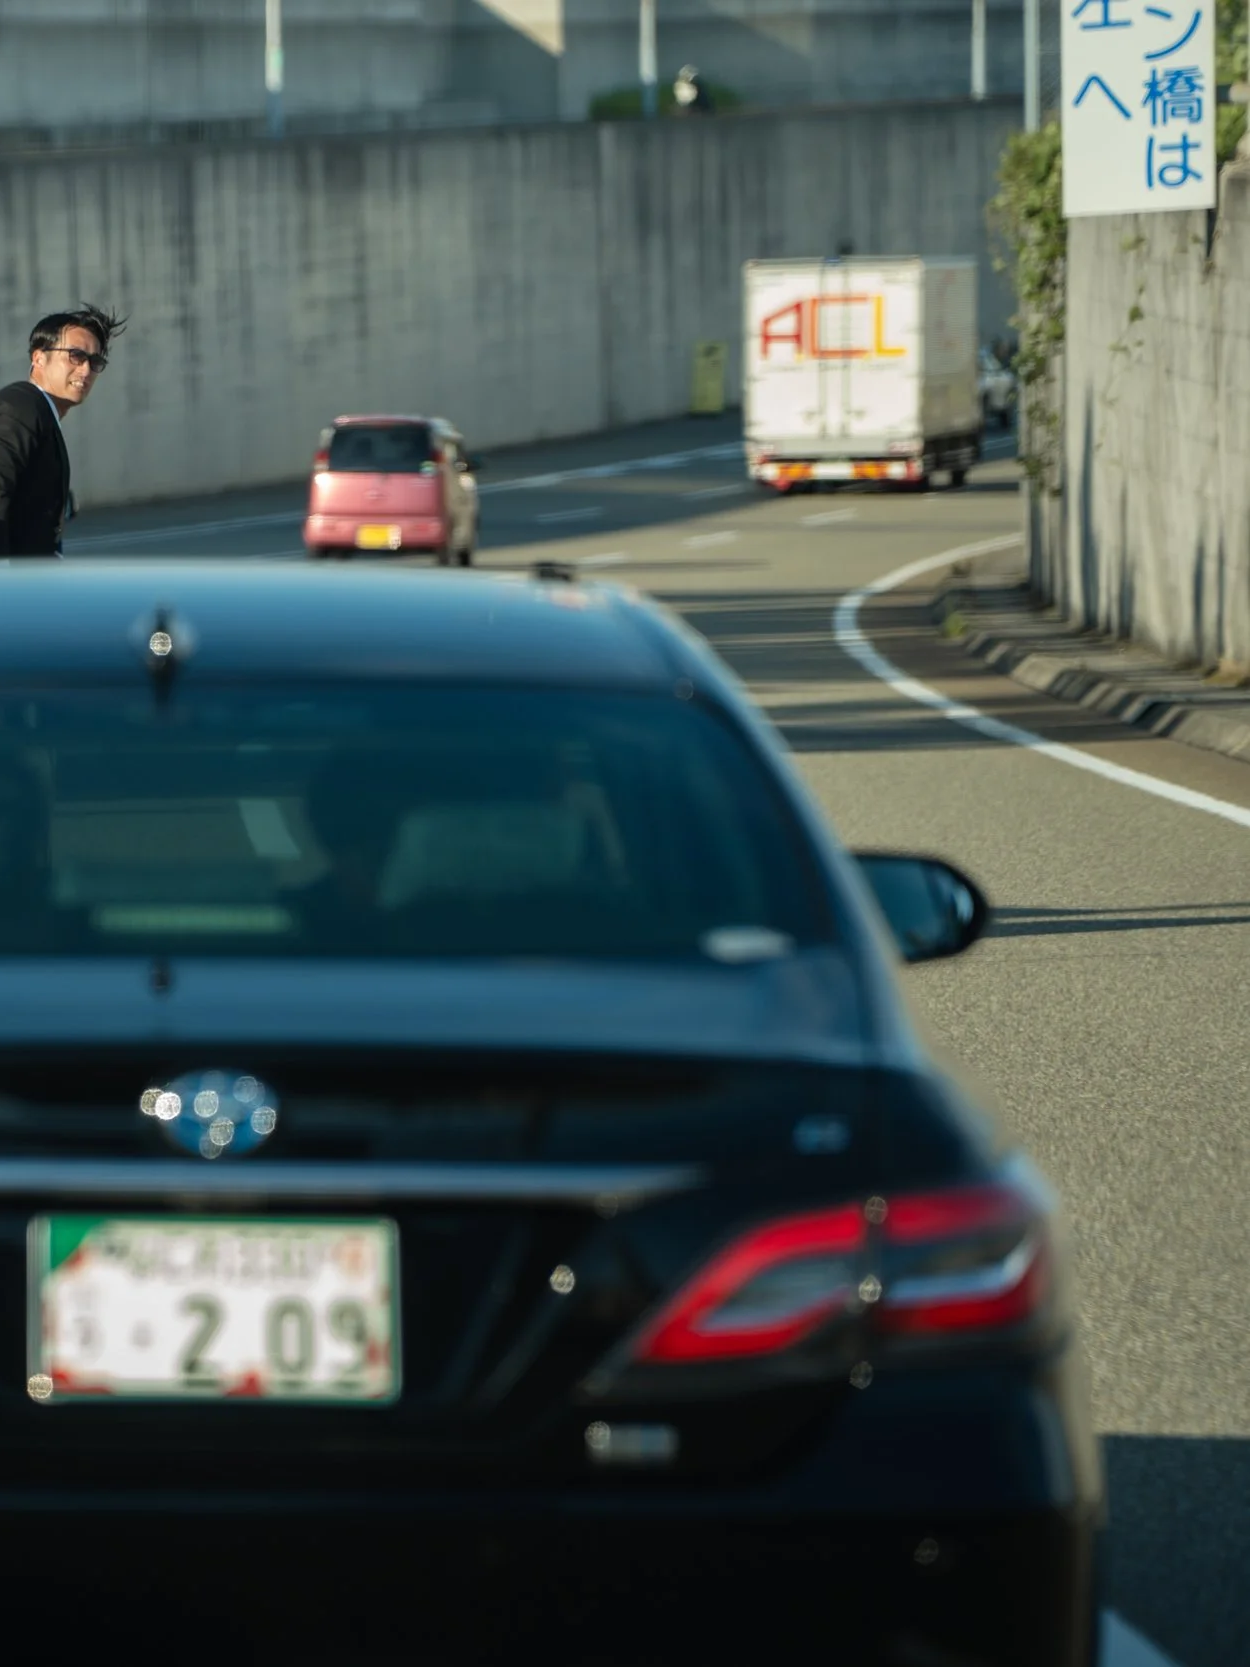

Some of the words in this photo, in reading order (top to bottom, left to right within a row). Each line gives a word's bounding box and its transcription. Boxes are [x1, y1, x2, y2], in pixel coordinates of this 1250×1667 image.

[1142, 7, 1204, 189] ン橋は
[761, 295, 907, 360] ACL
